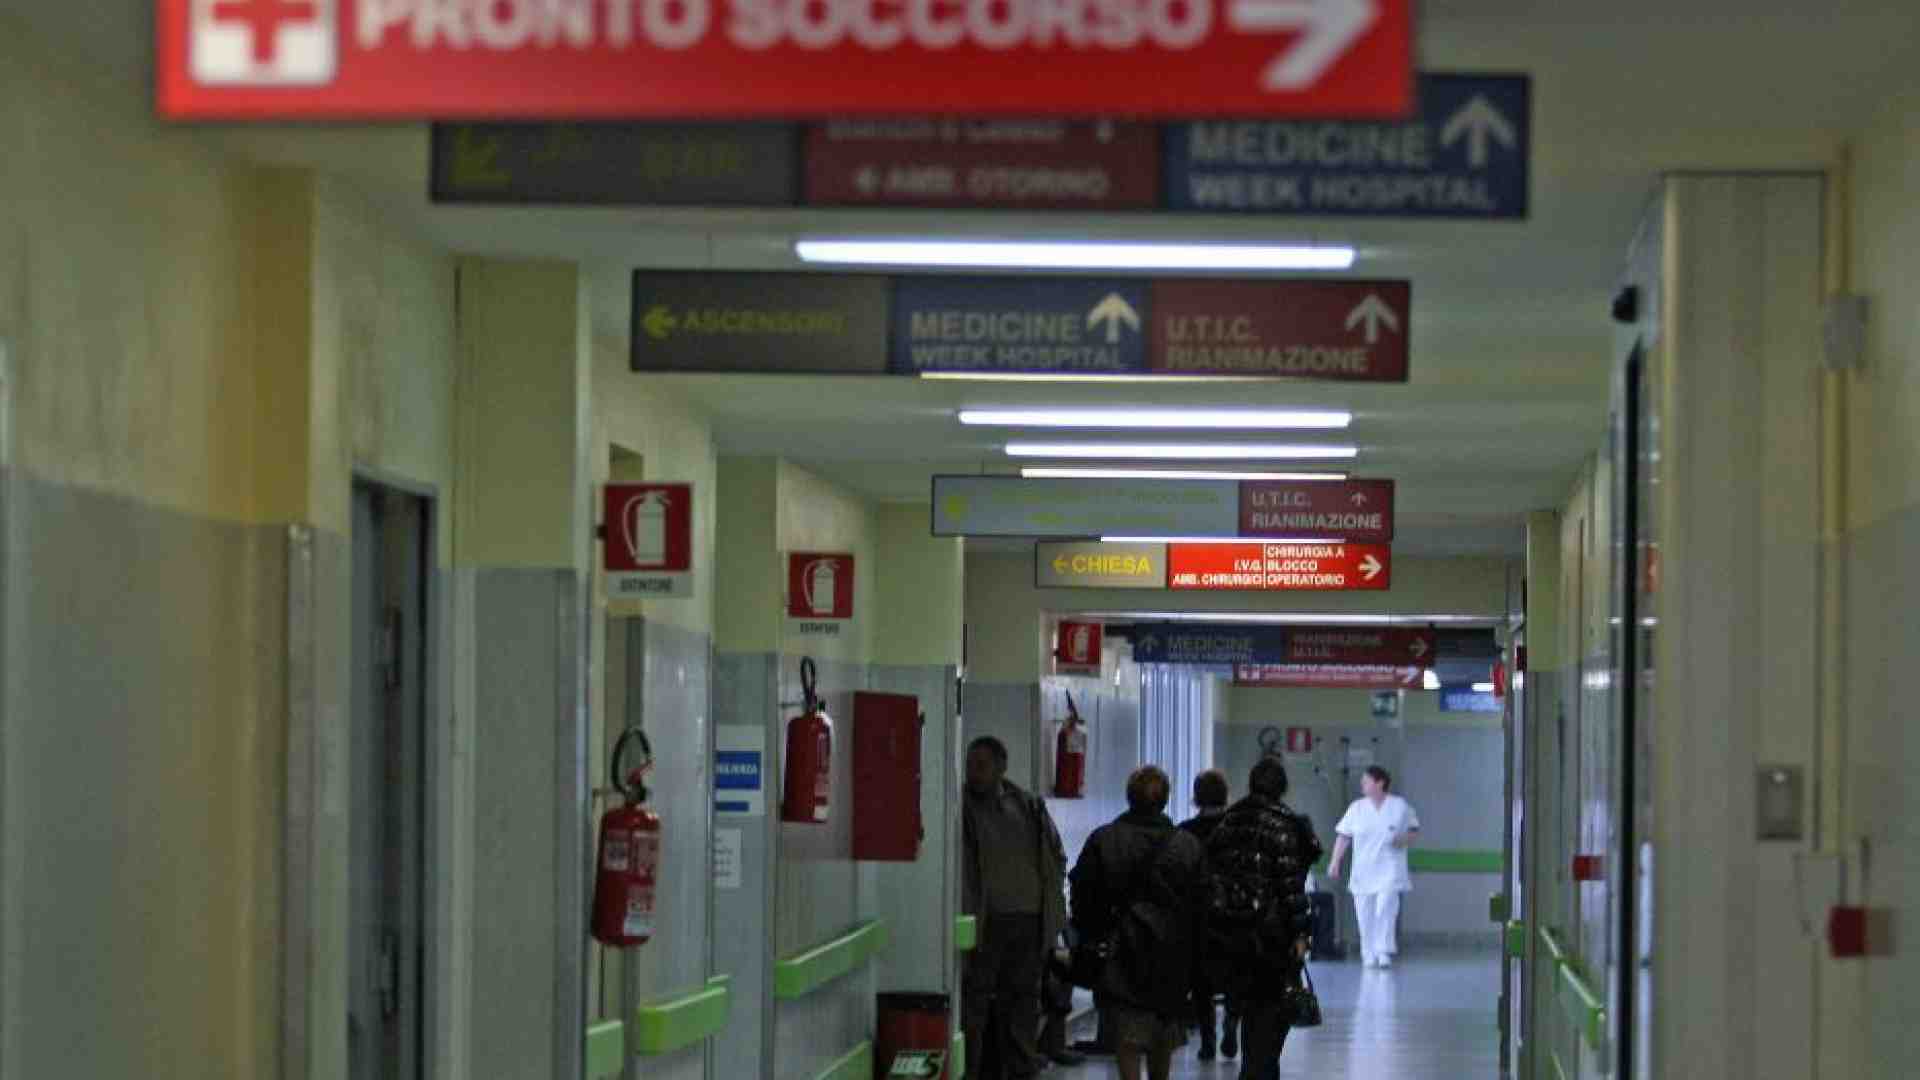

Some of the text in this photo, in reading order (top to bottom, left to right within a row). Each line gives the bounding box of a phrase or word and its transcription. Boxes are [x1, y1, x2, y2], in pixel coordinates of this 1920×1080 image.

[357, 0, 1208, 50] PRONTO SOCCORSO
[1188, 123, 1431, 167] MEDICINE
[1188, 175, 1490, 212] WEEK HOSPITAL
[681, 308, 846, 336] ASCENSORI
[911, 311, 1082, 340] MEDICINE
[1166, 315, 1258, 341] U.T.I.C.
[911, 344, 1127, 369] WEEK HOSPITAL
[1166, 345, 1369, 373] RIANIMAZIONE
[1251, 491, 1312, 508] U.T.I.C.
[1251, 512, 1383, 529] RIANIMAZIONE
[1267, 546, 1334, 559] CHIRURGIA
[1071, 555, 1152, 576] CHIESA
[1267, 559, 1318, 572] BLOCCO
[1267, 573, 1345, 586] OPERATORIO
